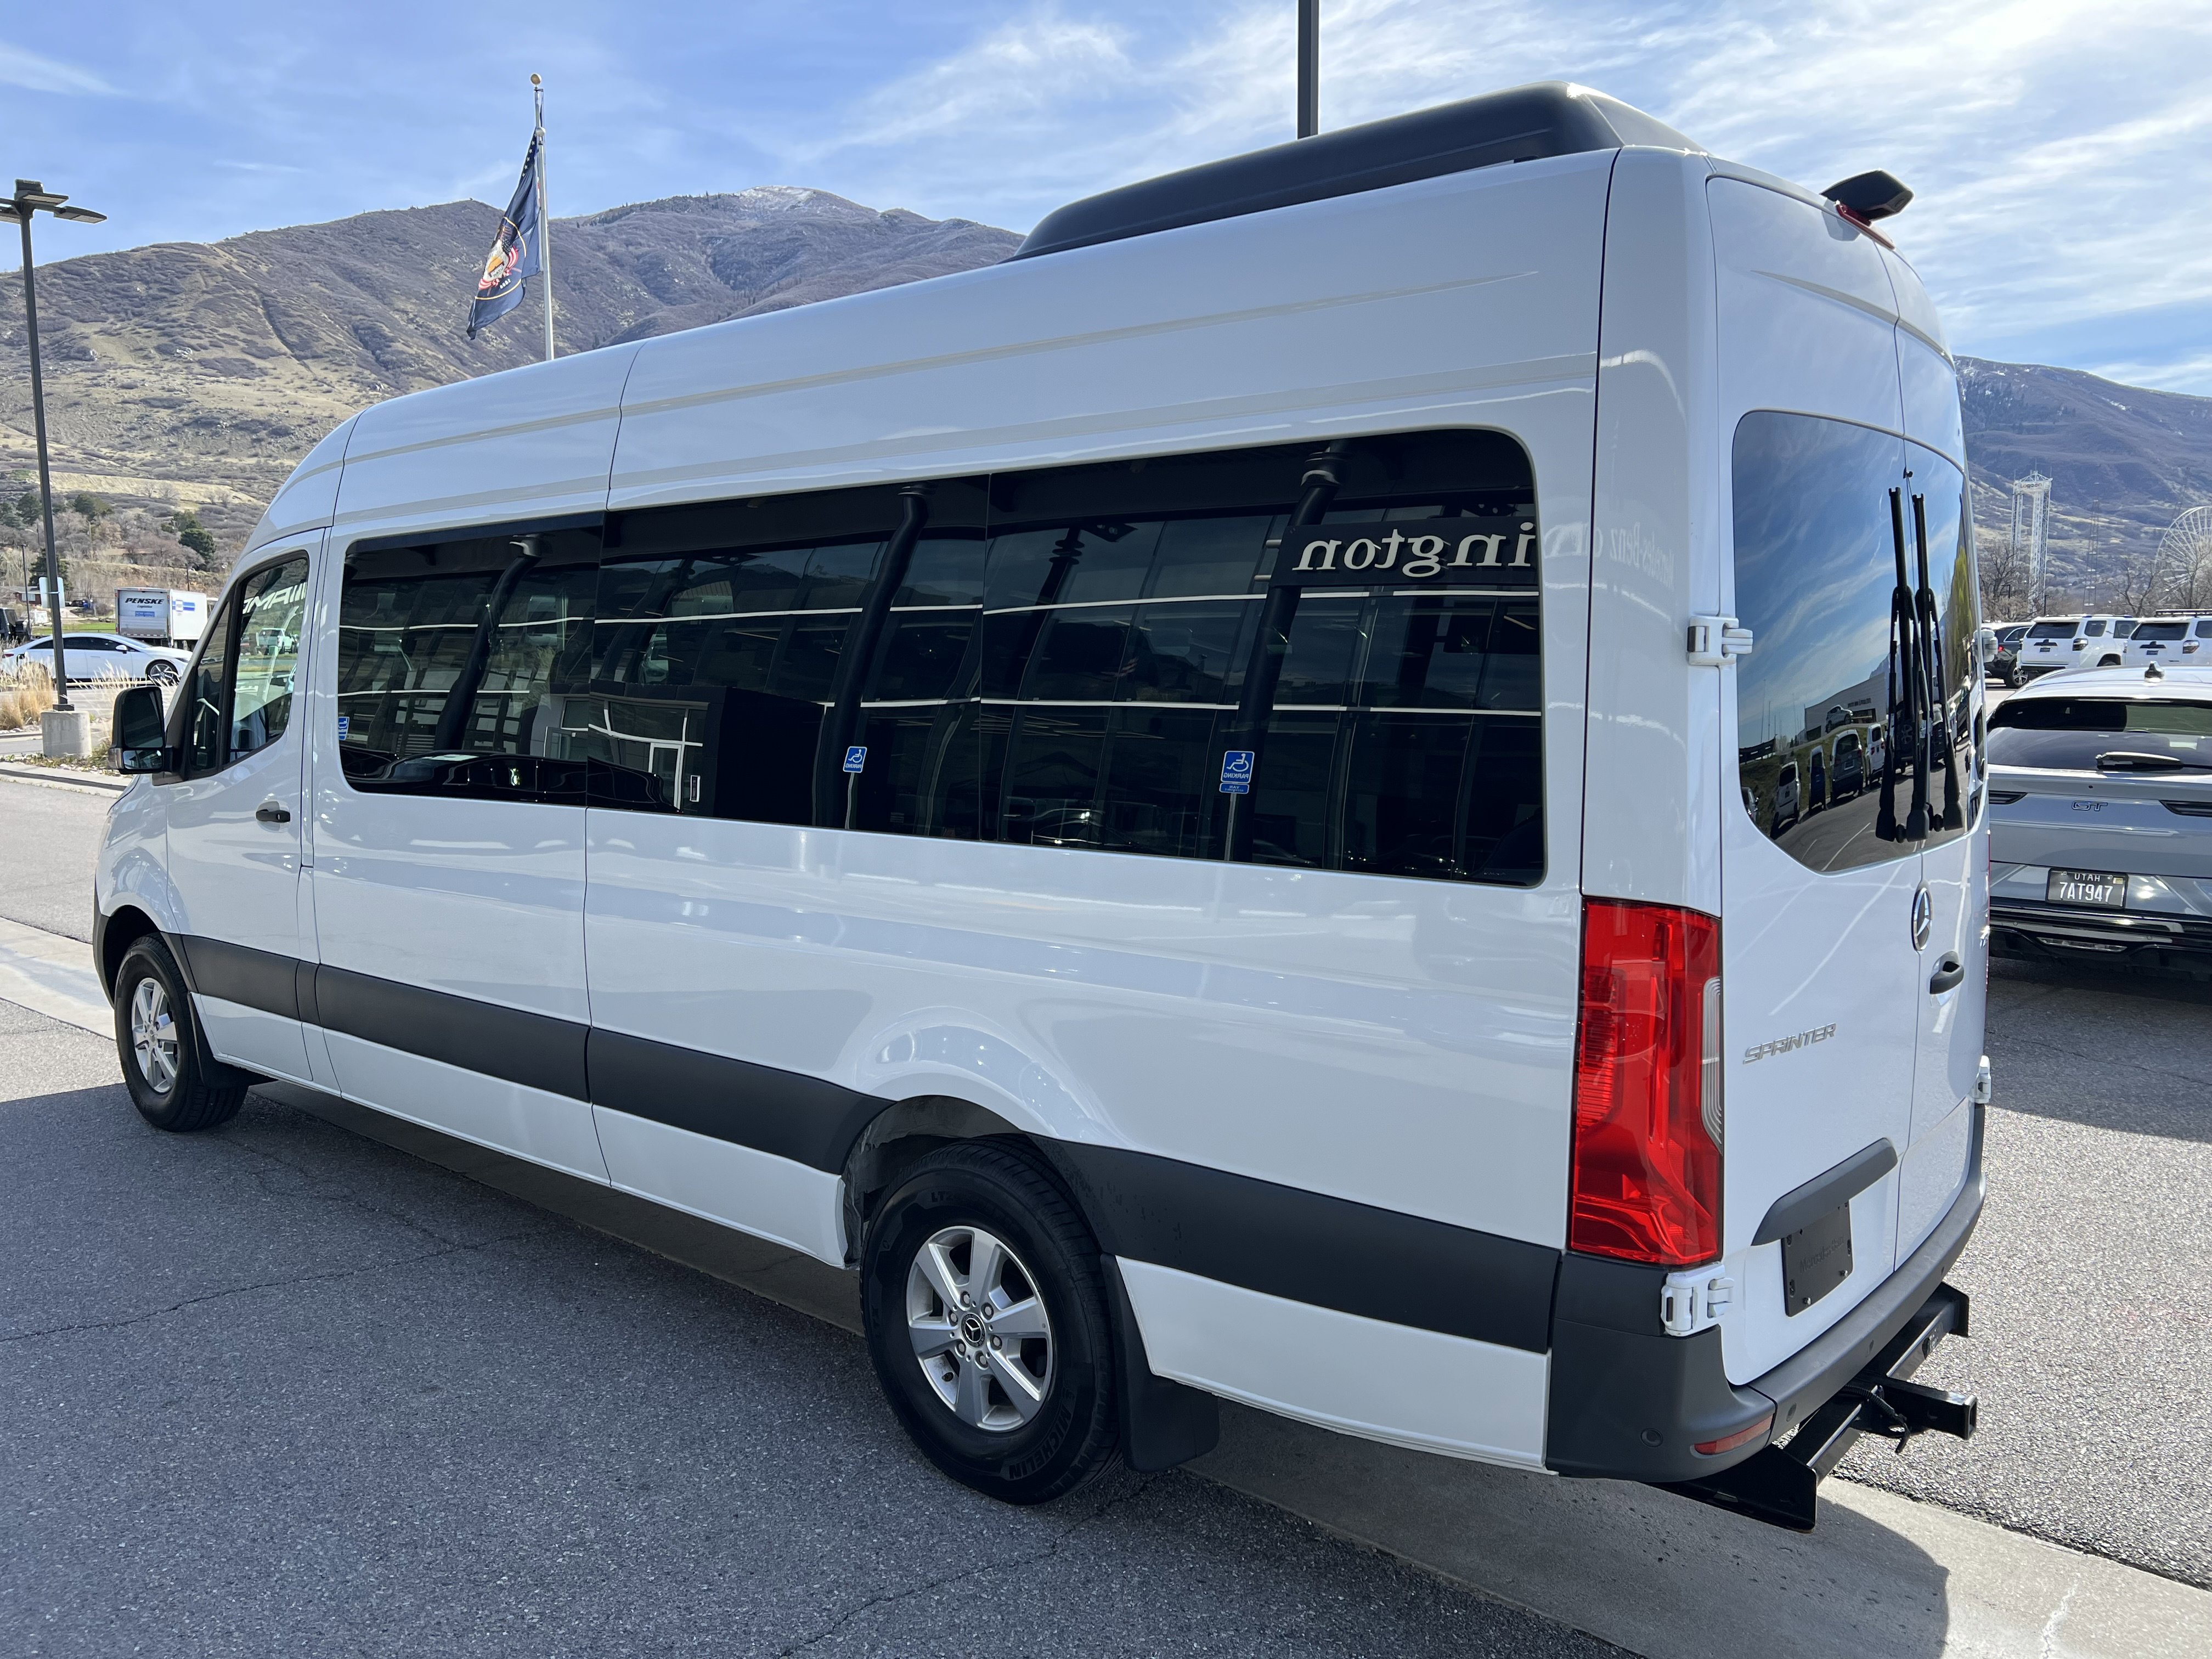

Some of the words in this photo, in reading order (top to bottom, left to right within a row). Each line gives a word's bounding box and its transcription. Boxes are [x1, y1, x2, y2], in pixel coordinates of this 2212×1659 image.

[2072, 800, 2108, 812] GT
[2074, 873, 2101, 882] UTAH
[2059, 882, 2113, 902] 7AT947
[1742, 1022, 1837, 1064] SPRINTER
[1008, 1403, 1073, 1480] MICHELIN
